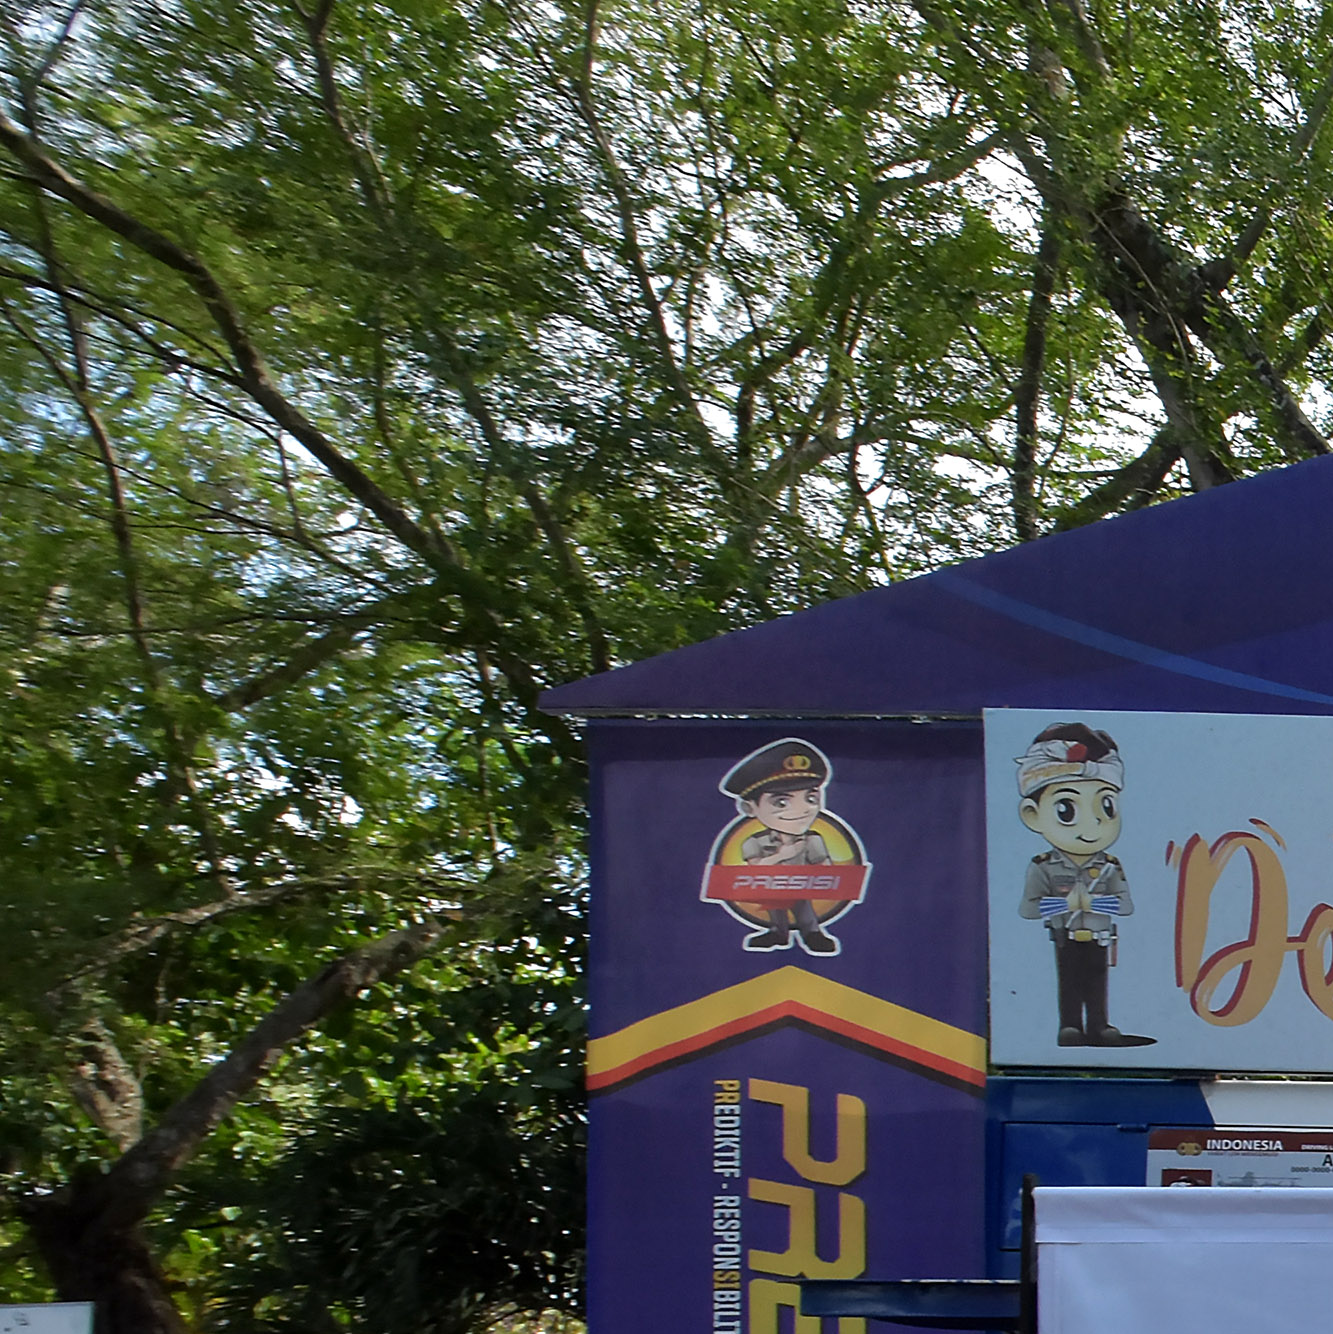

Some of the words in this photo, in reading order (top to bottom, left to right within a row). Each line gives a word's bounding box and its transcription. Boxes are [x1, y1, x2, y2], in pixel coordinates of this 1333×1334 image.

[733, 875, 841, 890] PRESISI
[712, 1079, 742, 1178] PREDIKTIF
[1206, 1138, 1284, 1152] INDONESIA
[1322, 1154, 1333, 1167] A
